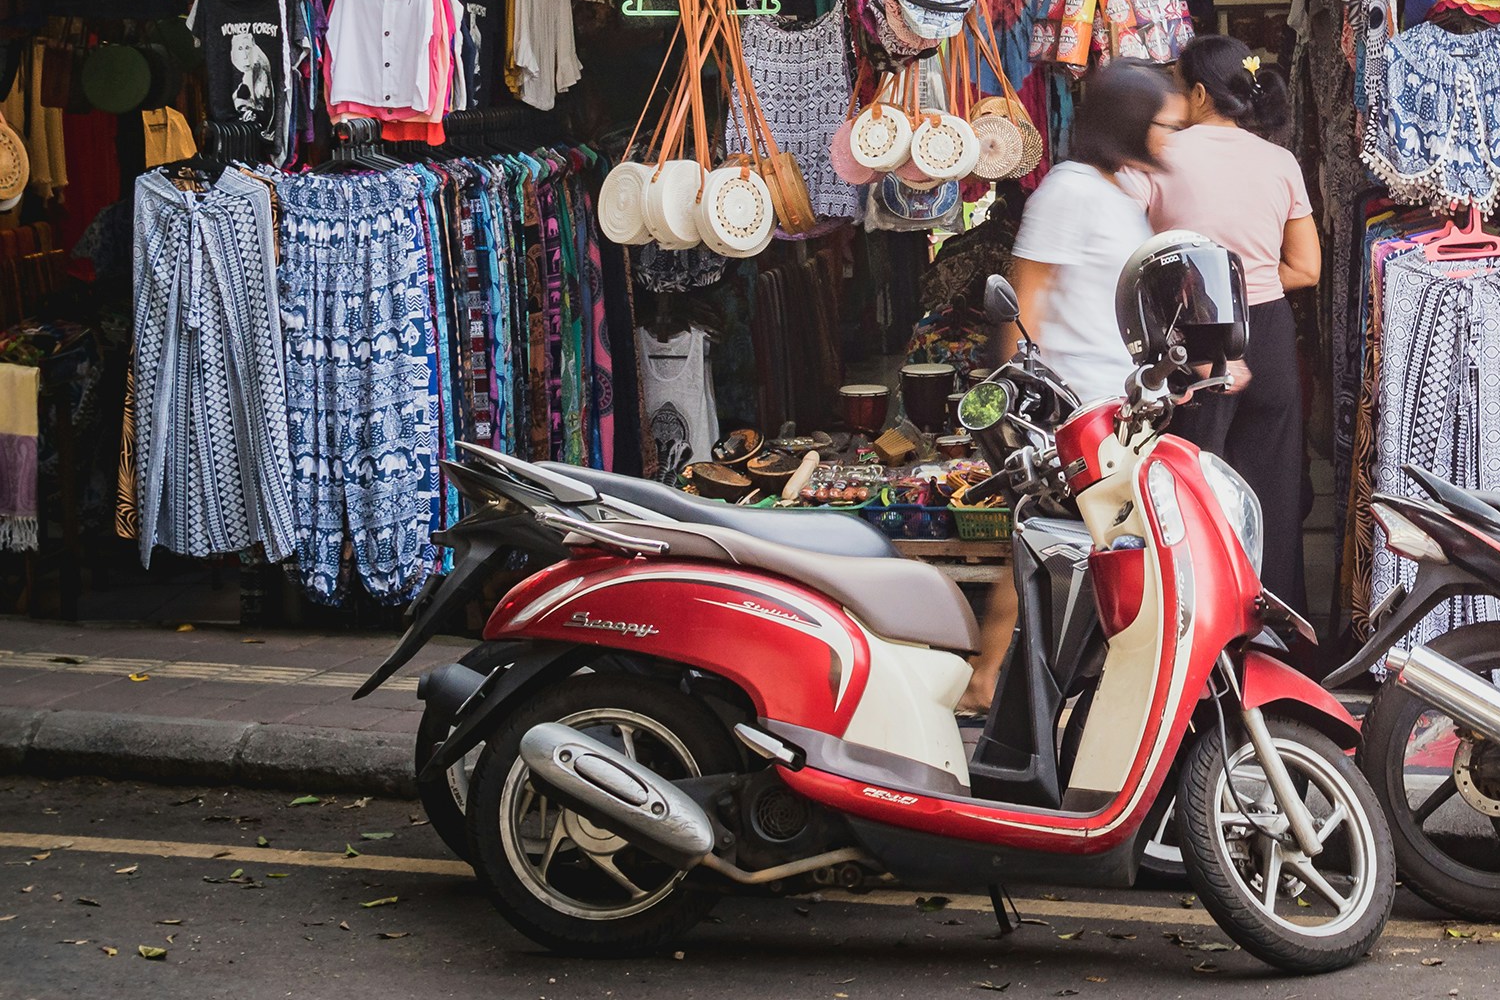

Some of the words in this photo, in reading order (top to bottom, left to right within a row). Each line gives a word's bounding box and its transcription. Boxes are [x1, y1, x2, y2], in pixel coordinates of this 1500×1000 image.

[252, 22, 279, 37] FOREST
[741, 600, 803, 621] Stylish
[563, 611, 660, 637] Scoopy
